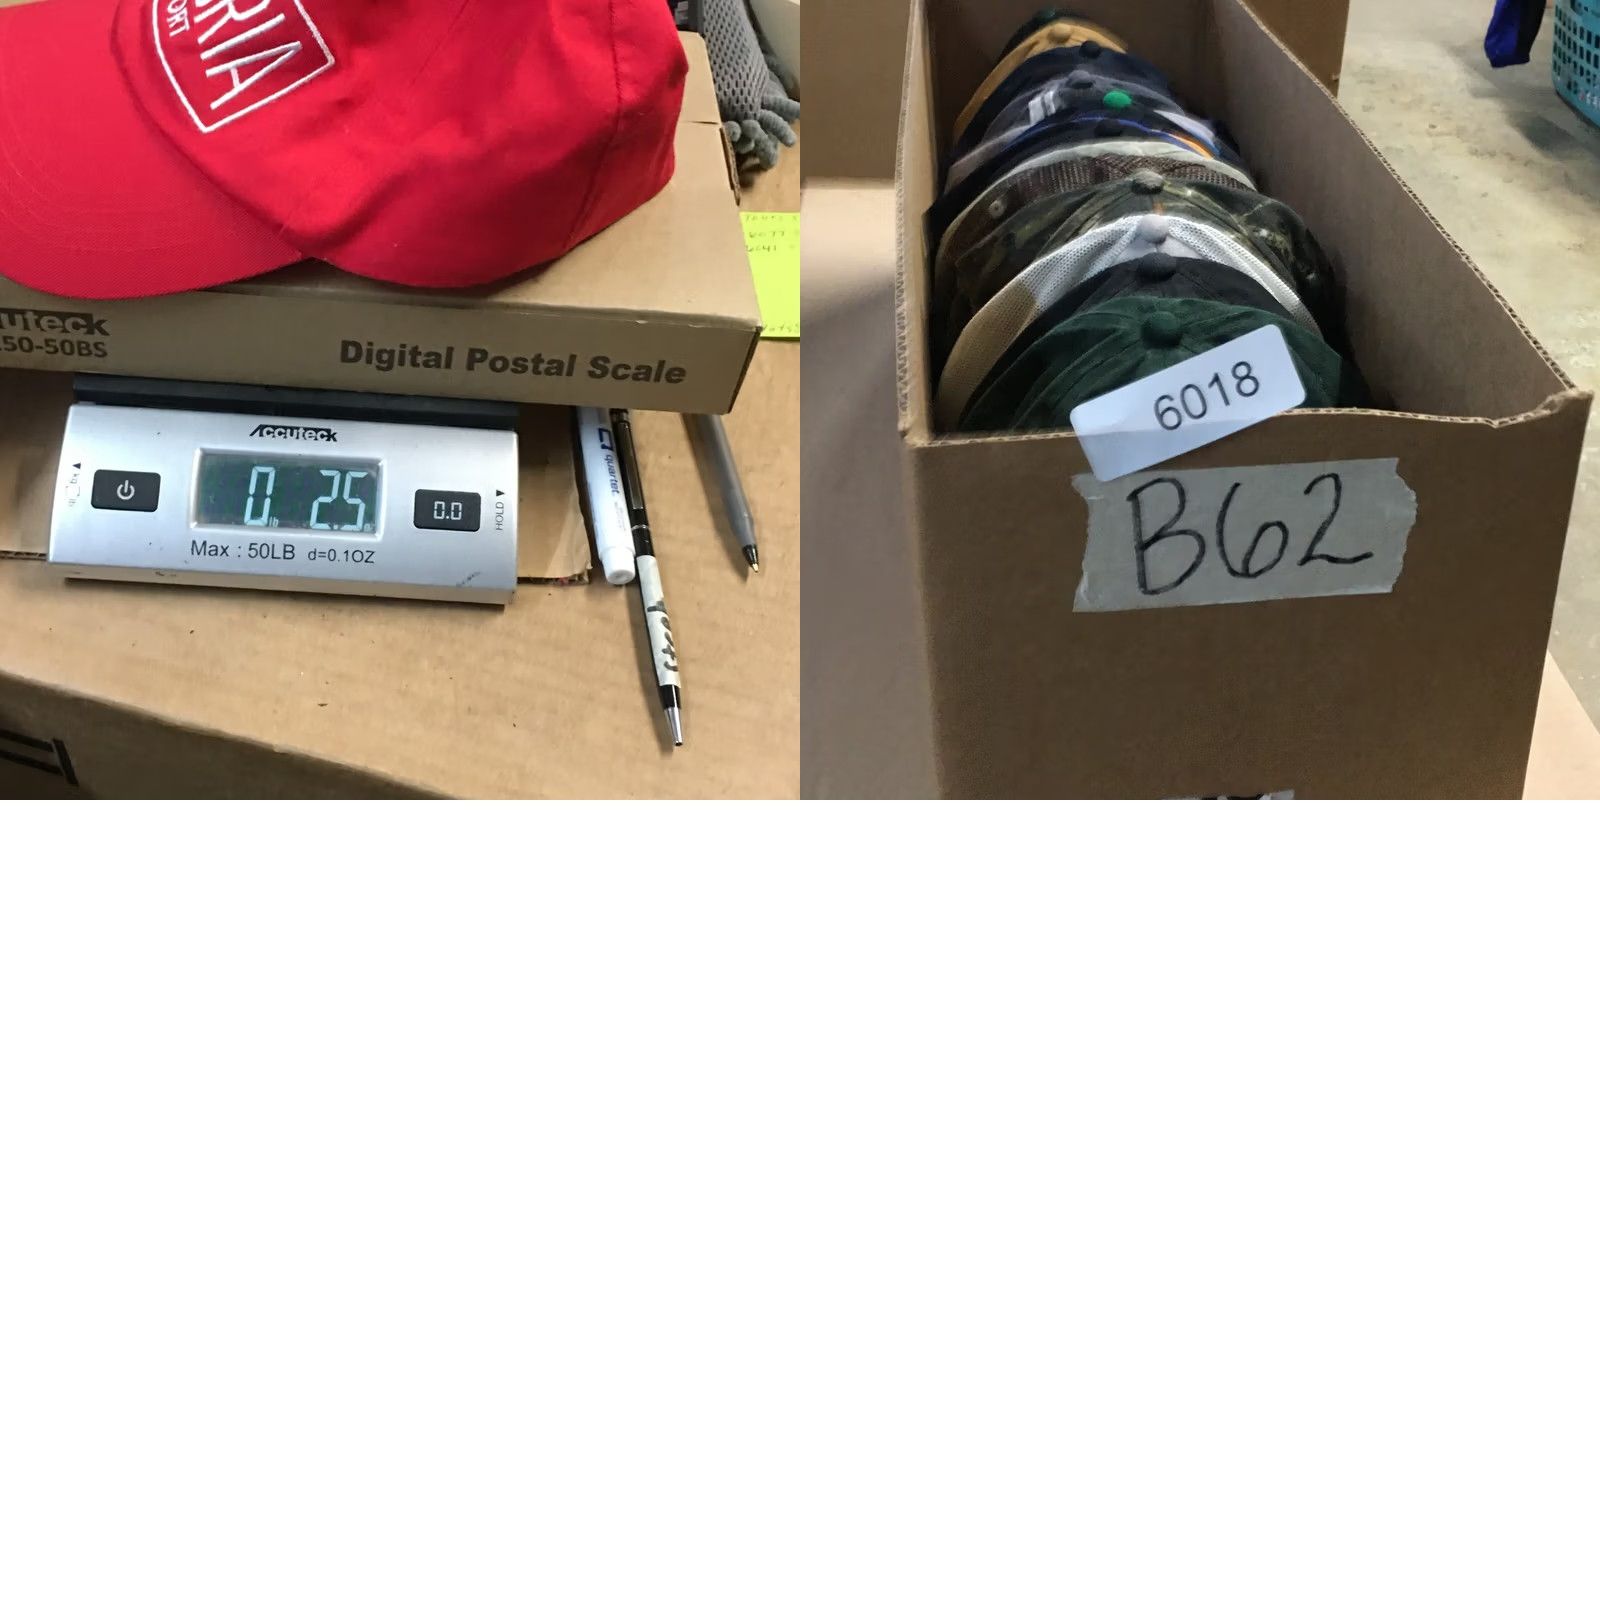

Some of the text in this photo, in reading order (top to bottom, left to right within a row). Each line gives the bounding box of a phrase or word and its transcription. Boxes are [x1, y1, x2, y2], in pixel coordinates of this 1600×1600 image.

[194, 0, 303, 110] RIA
[0, 335, 108, 358] 50-50BS
[339, 339, 688, 385] Digital Postal Scale
[1152, 360, 1260, 431] 6018
[249, 424, 338, 442] Accuteck
[604, 454, 620, 495] quartet
[243, 466, 276, 527] 0
[309, 469, 369, 532] 2.5
[433, 501, 463, 521] 0.0
[495, 501, 504, 531] HOLD
[190, 539, 230, 558] Max
[247, 542, 296, 561] 50LB
[307, 547, 377, 564] d=0.1OZ
[1126, 472, 1374, 595] B62
